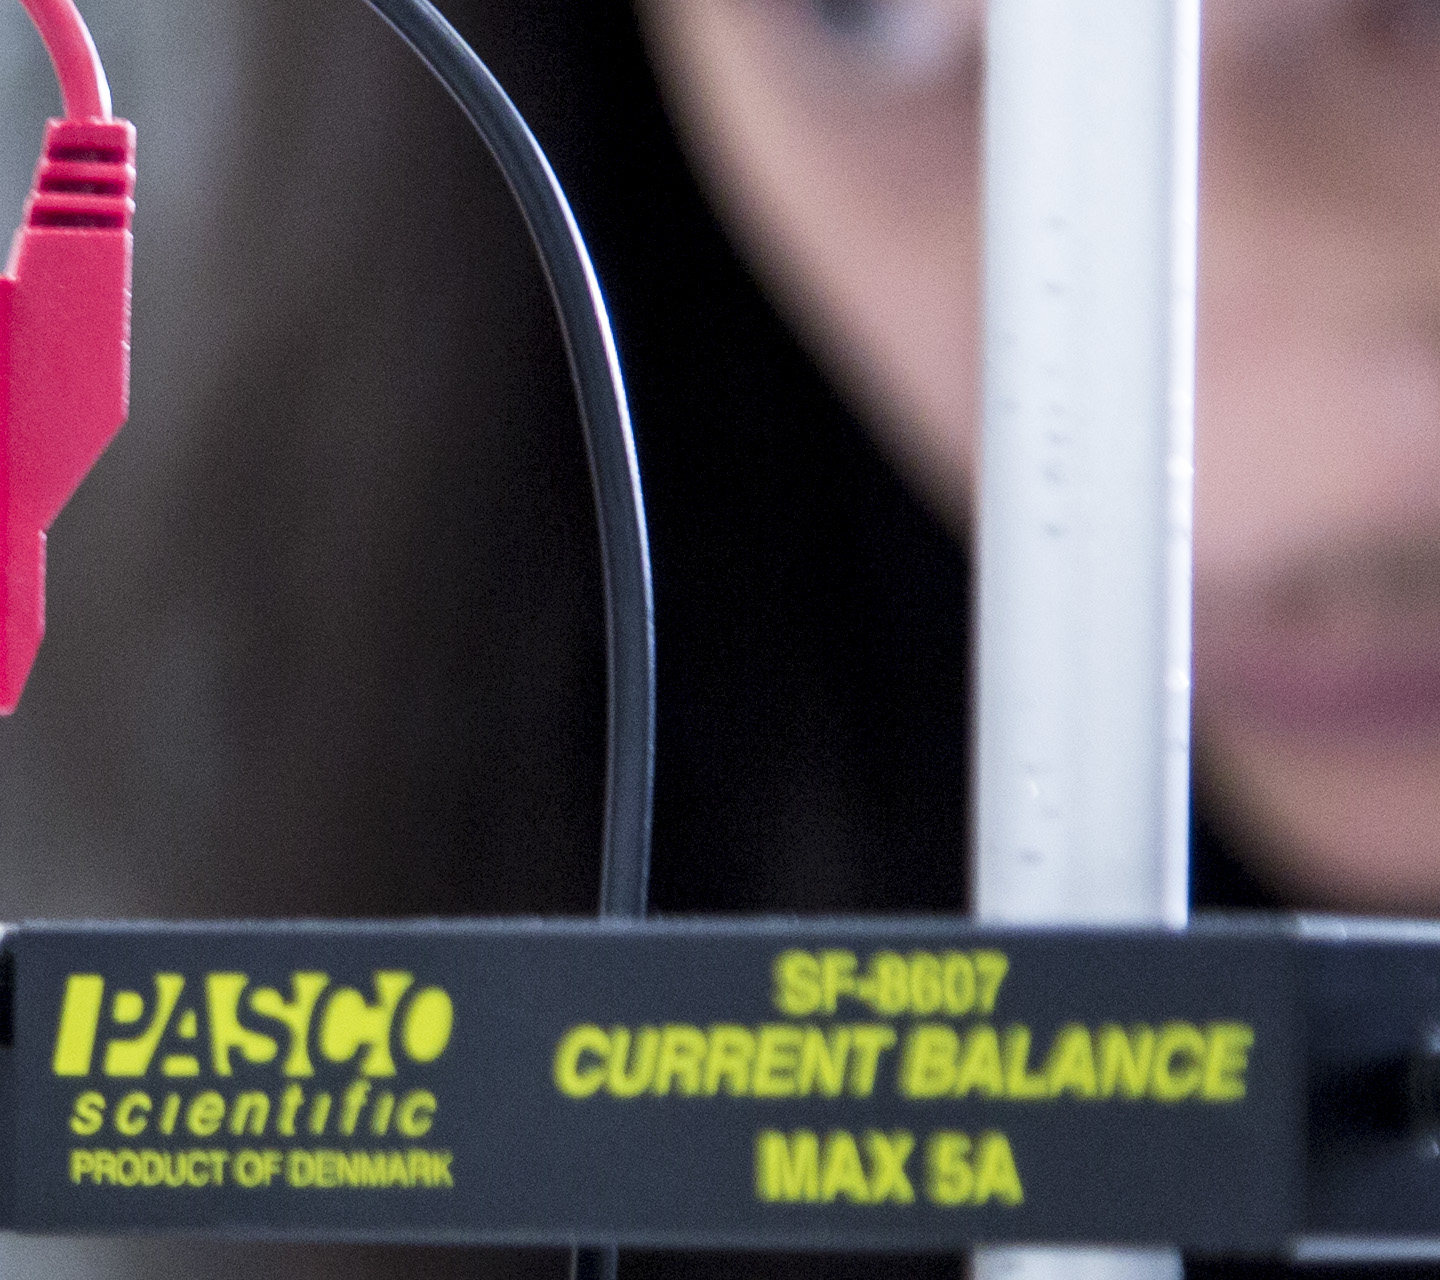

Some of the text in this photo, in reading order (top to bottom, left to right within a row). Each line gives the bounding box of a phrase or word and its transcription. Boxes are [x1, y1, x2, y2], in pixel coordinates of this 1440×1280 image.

[775, 949, 1009, 1016] SF-8607
[52, 970, 453, 1077] PASCO
[553, 1023, 1254, 1102] CURRENT BALANCE
[69, 1077, 437, 1137] scientific
[69, 1148, 453, 1188] PRODUCT OF DENMARK
[755, 1129, 1023, 1205] MAX 5A
